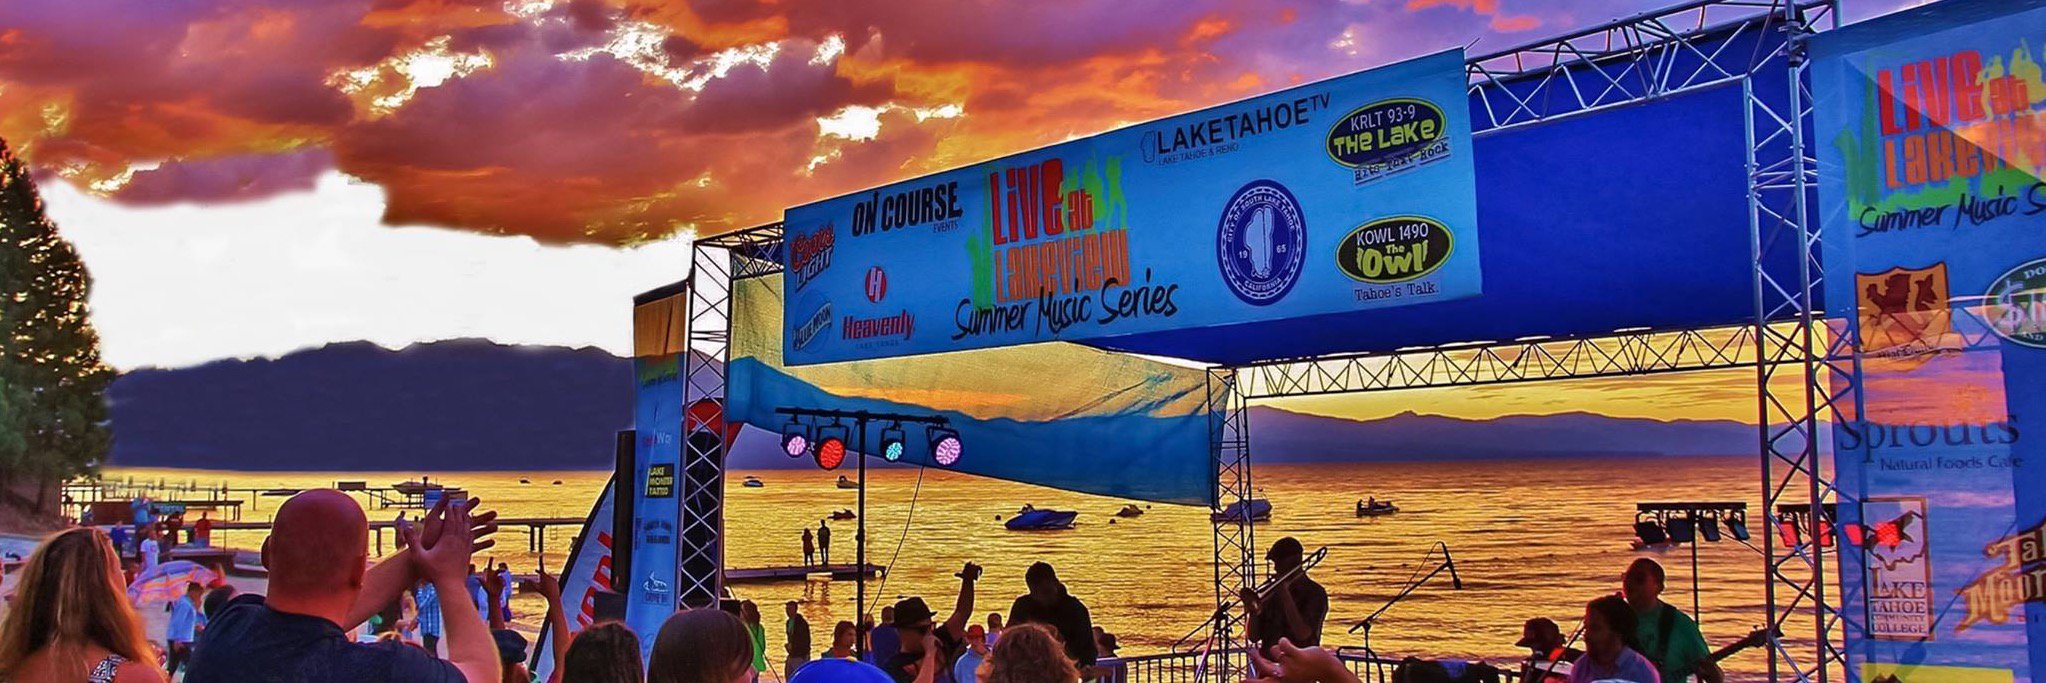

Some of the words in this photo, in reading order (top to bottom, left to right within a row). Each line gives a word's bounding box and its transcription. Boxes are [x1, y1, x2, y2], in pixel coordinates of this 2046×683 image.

[1350, 110, 1383, 132] KRLT
[881, 181, 964, 232] COURSE
[1068, 188, 1094, 232] at
[1856, 203, 1951, 238] Summer
[1954, 185, 2018, 231] Music
[1356, 227, 1395, 246] KOWL
[1399, 222, 1429, 241] 1490
[1238, 250, 1249, 260] 19
[1275, 244, 1287, 254] 65
[1385, 243, 1405, 254] The
[796, 246, 834, 293] LIGHT
[1244, 277, 1282, 291] CALIFORNIA
[1354, 285, 1402, 301] Tahoe's
[951, 298, 1033, 341] Summer
[1035, 277, 1094, 338] Music
[1097, 267, 1179, 326] Series
[842, 309, 915, 341] Heavenly
[1880, 457, 1933, 471] Natural
[1937, 456, 1983, 469] Foods
[1869, 567, 1925, 599] LAKE
[1871, 600, 1925, 614] TAHOE
[1871, 623, 1927, 634] COLLEGE
